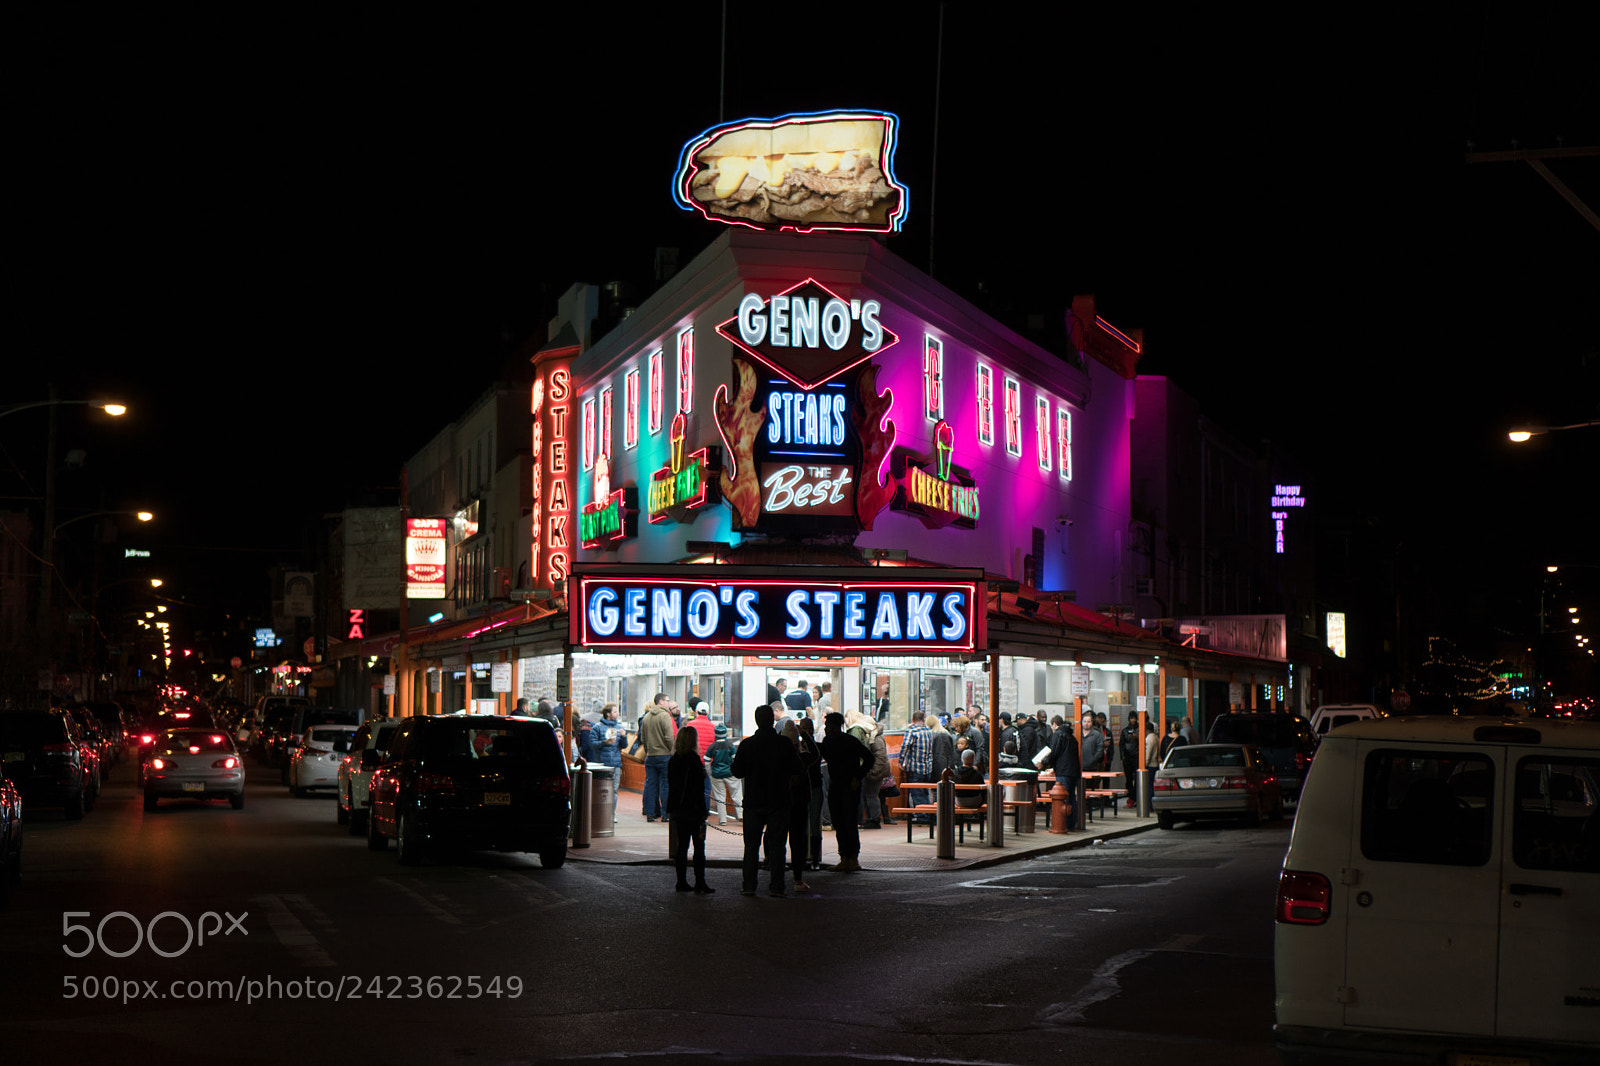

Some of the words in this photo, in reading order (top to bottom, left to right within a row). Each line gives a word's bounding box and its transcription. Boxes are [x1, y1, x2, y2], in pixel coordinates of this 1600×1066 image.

[738, 293, 883, 352] GENO'S
[768, 391, 846, 446] STEAKS
[549, 369, 570, 585] STEAKS
[764, 465, 852, 512] Best
[808, 467, 831, 479] THE
[1275, 484, 1301, 496] Happy
[911, 466, 950, 512] CHEESE
[951, 484, 980, 521] FRIES
[1271, 496, 1305, 507] Birthday
[410, 529, 442, 538] CREMA
[1275, 519, 1285, 553] BAR
[415, 565, 436, 573] KING
[588, 586, 760, 639] GENO'S
[786, 588, 967, 641] STEAKS
